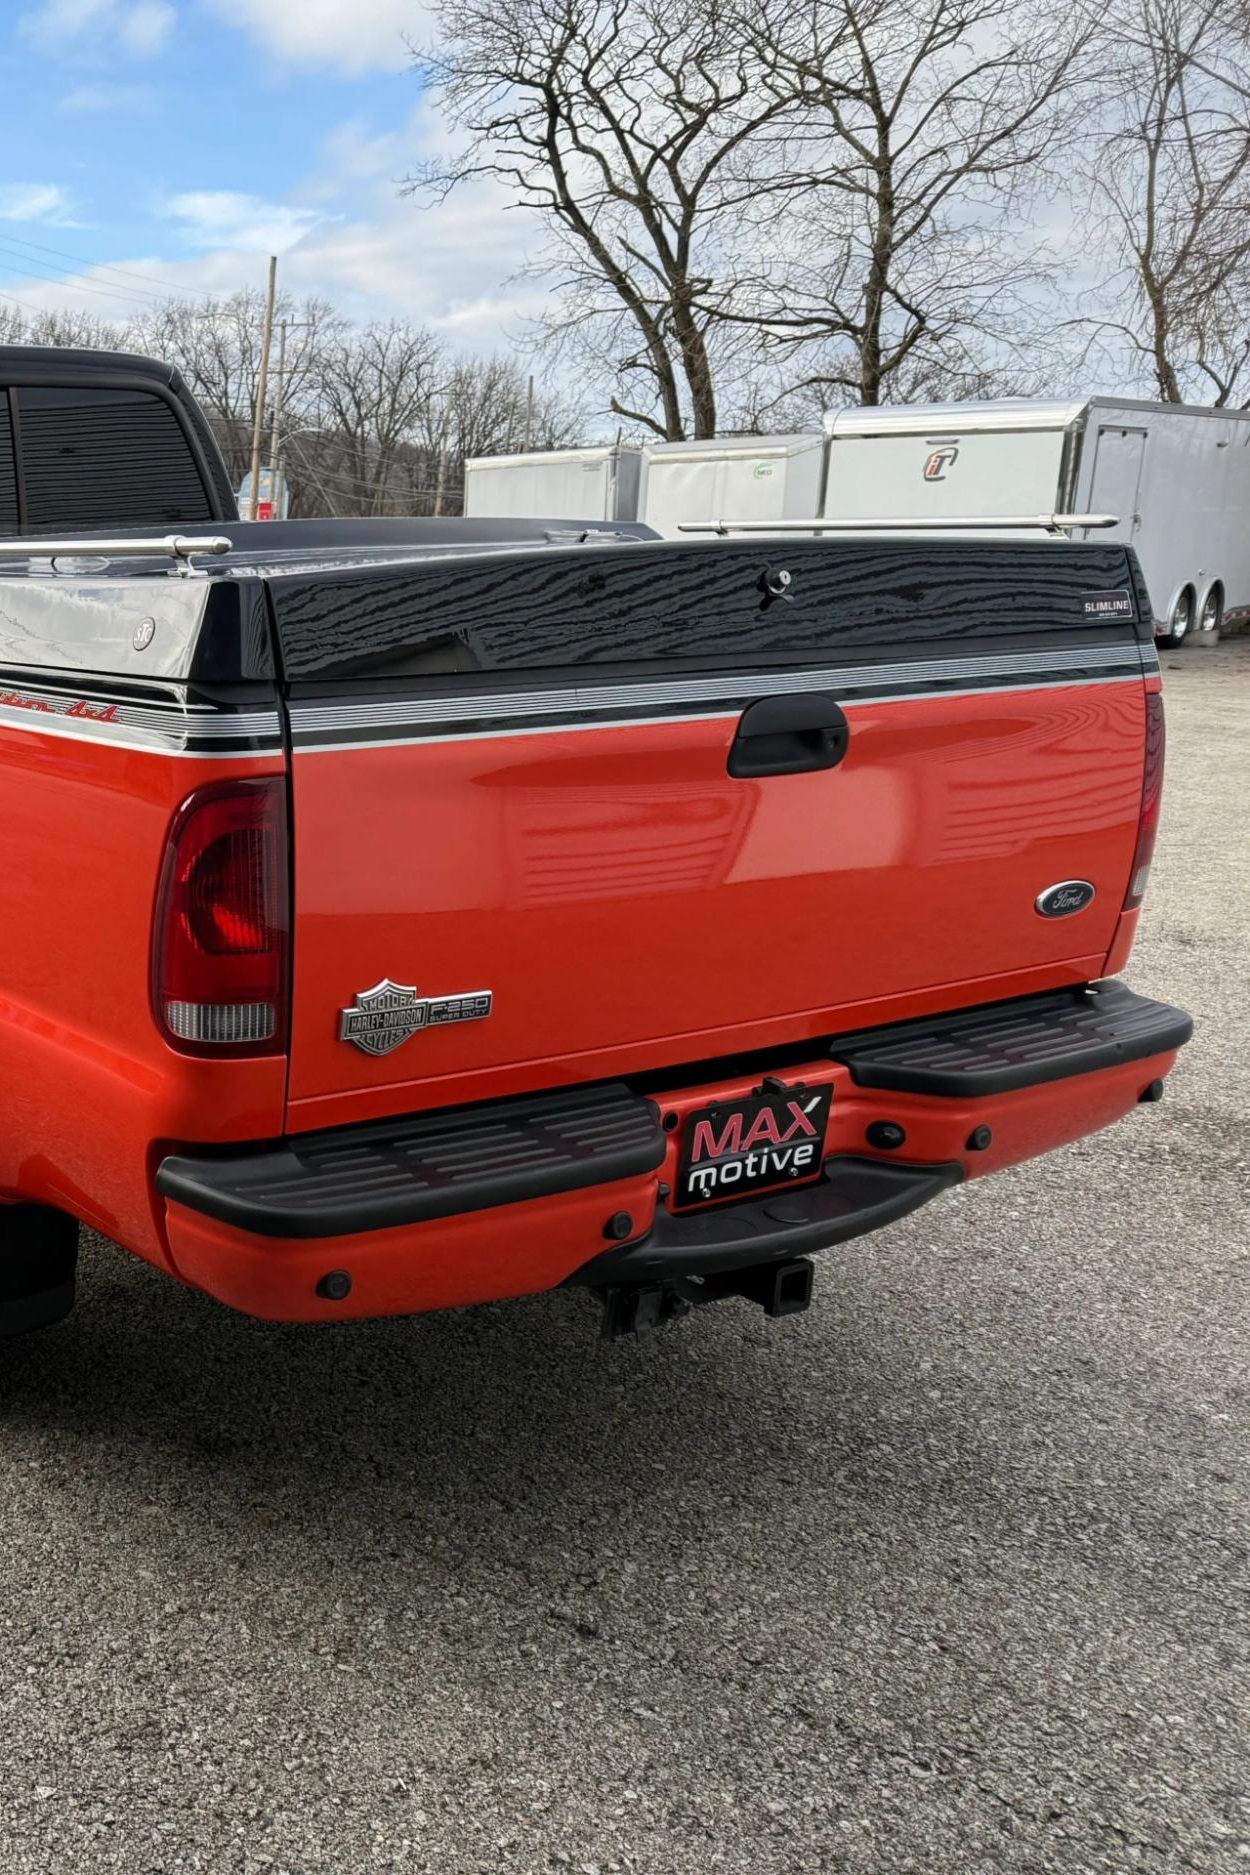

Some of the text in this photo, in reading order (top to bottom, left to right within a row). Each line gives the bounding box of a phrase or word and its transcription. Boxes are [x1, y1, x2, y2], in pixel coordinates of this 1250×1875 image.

[1085, 600, 1129, 612] SLIMLINE
[1052, 889, 1083, 909] Ford
[370, 993, 408, 1010] MOTOR
[430, 997, 488, 1015] F-250
[350, 1008, 423, 1032] HARLEY-DAVIDSON
[429, 1008, 488, 1022] SUPER DUTY
[366, 1030, 405, 1050] CYCLES
[691, 1096, 822, 1163] MAX
[688, 1144, 814, 1192] motive
